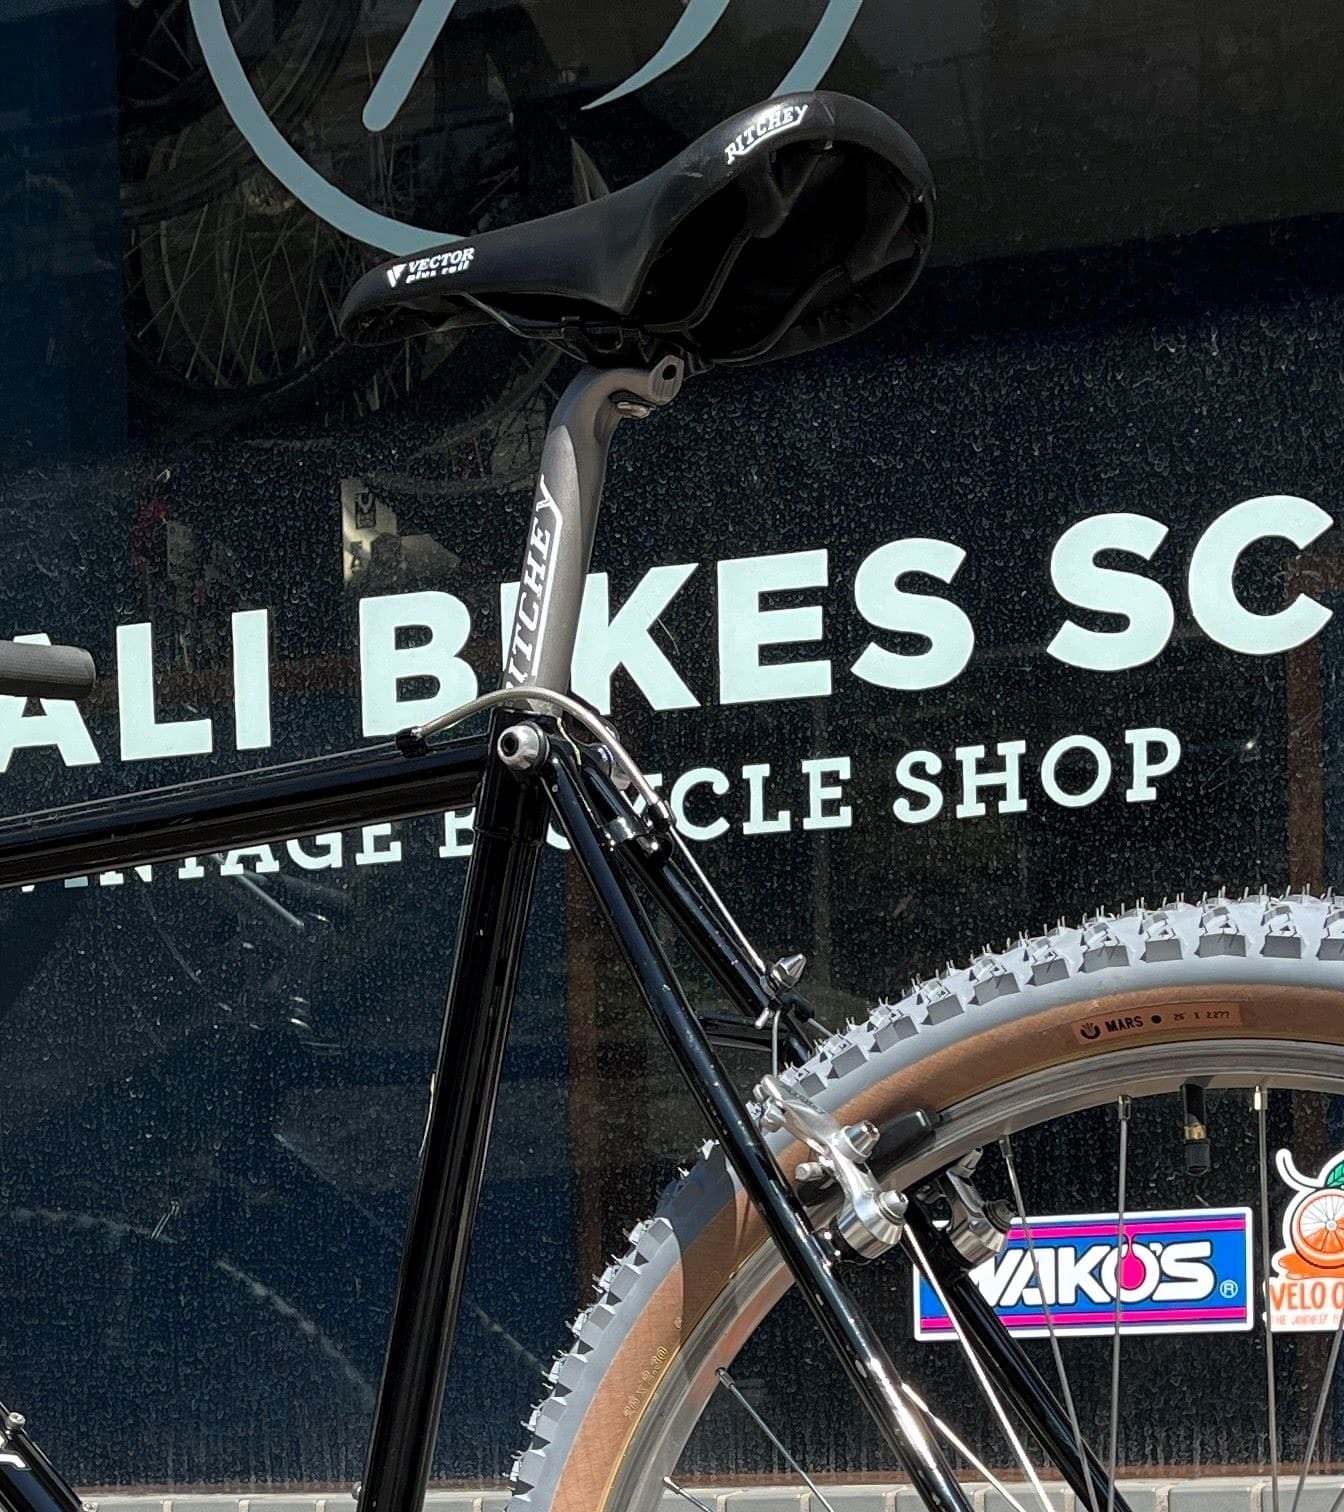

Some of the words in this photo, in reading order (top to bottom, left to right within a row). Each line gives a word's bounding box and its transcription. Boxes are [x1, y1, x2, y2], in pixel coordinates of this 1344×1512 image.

[724, 104, 809, 165] RITCHEY
[408, 247, 475, 273] VECTOR
[505, 473, 563, 689] ITCHEY
[1046, 494, 1335, 672] SC
[892, 726, 1182, 825] SHOP
[1105, 1006, 1144, 1032] MARS
[1269, 1281, 1326, 1311] VELO
